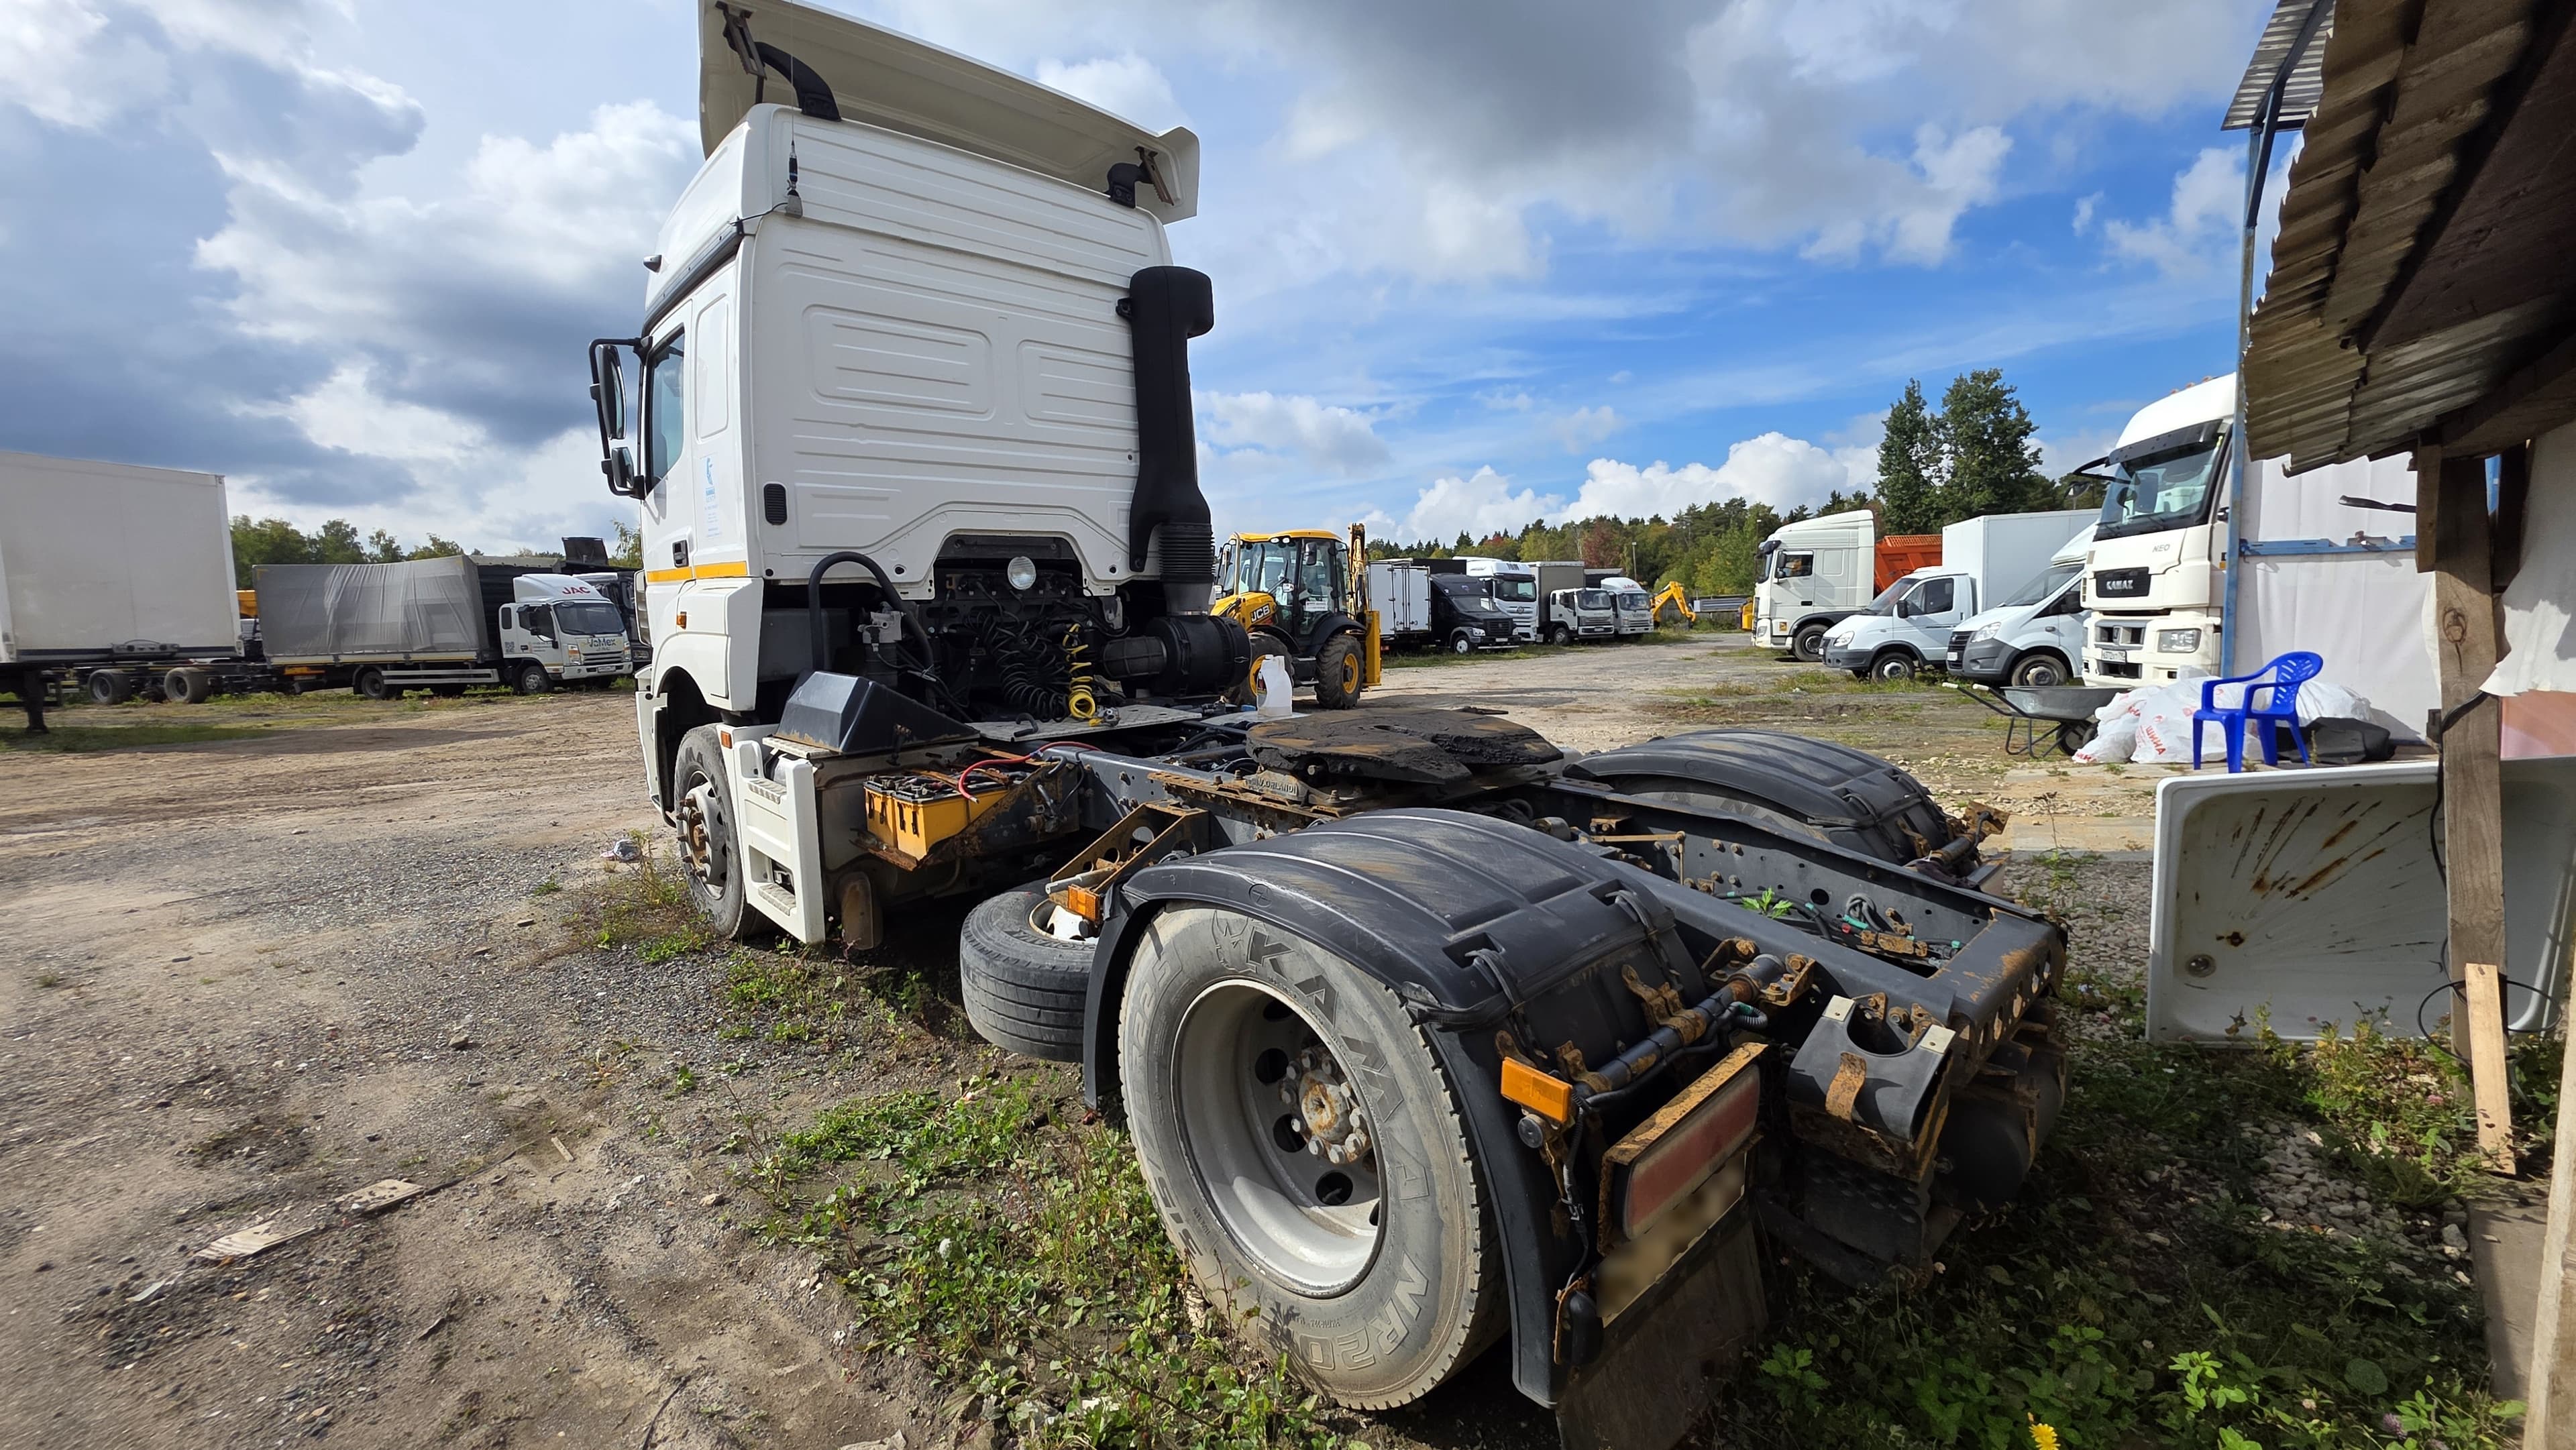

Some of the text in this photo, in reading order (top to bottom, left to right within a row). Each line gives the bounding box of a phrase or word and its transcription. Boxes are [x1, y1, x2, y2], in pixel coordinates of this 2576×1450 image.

[2152, 544, 2170, 553] NEO
[562, 586, 590, 594] JAC
[2106, 579, 2134, 590] KAMAZ
[1251, 605, 1270, 622] JCB
[2146, 726, 2166, 755] ШИНА
[1247, 926, 1430, 1200] KAMA
